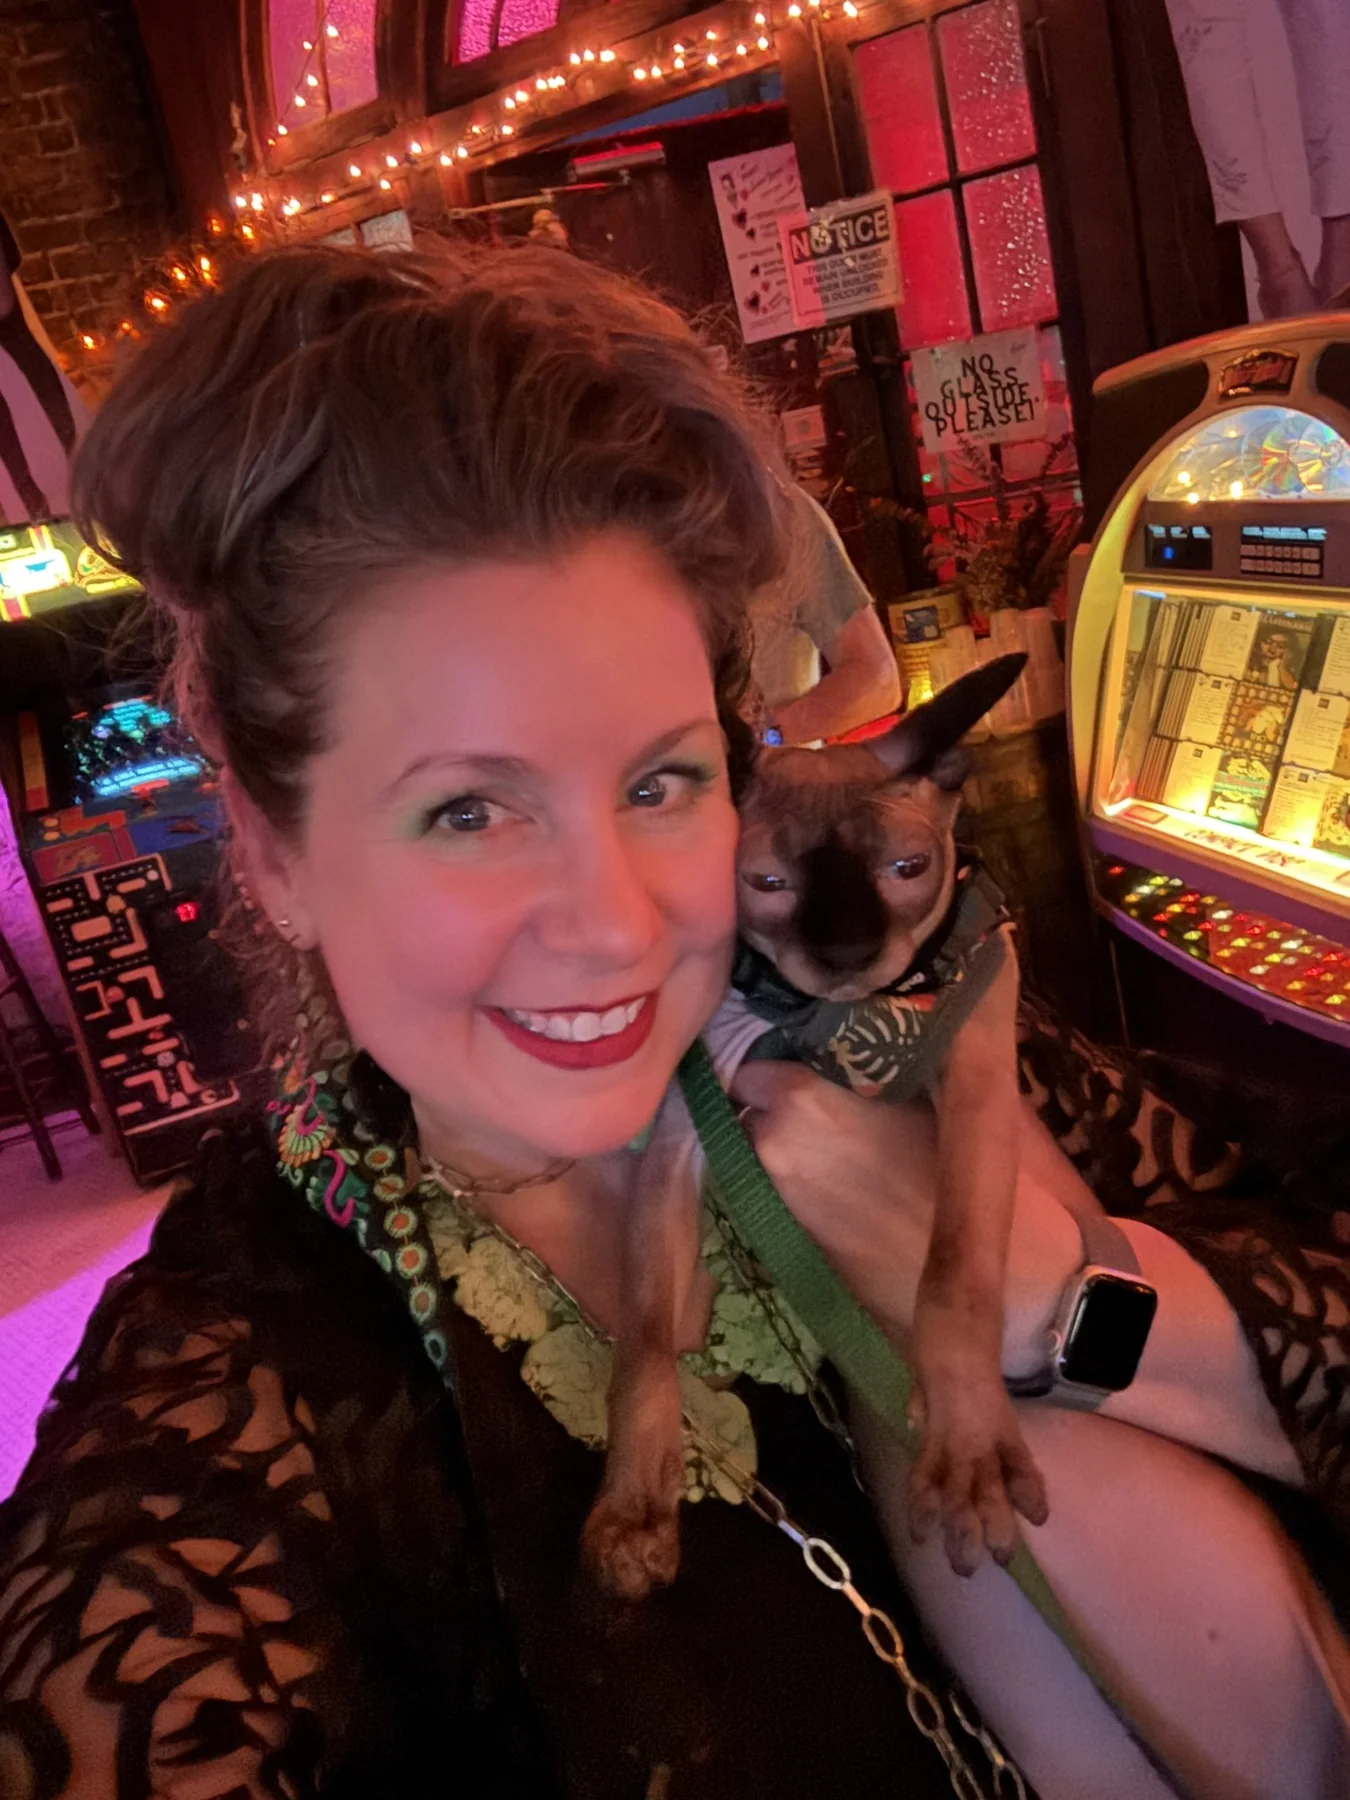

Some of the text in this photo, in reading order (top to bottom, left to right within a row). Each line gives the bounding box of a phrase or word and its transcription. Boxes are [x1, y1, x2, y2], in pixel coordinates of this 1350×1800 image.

[791, 210, 889, 260] NOTICE
[961, 354, 993, 377] NO
[940, 367, 1018, 399] GLASS
